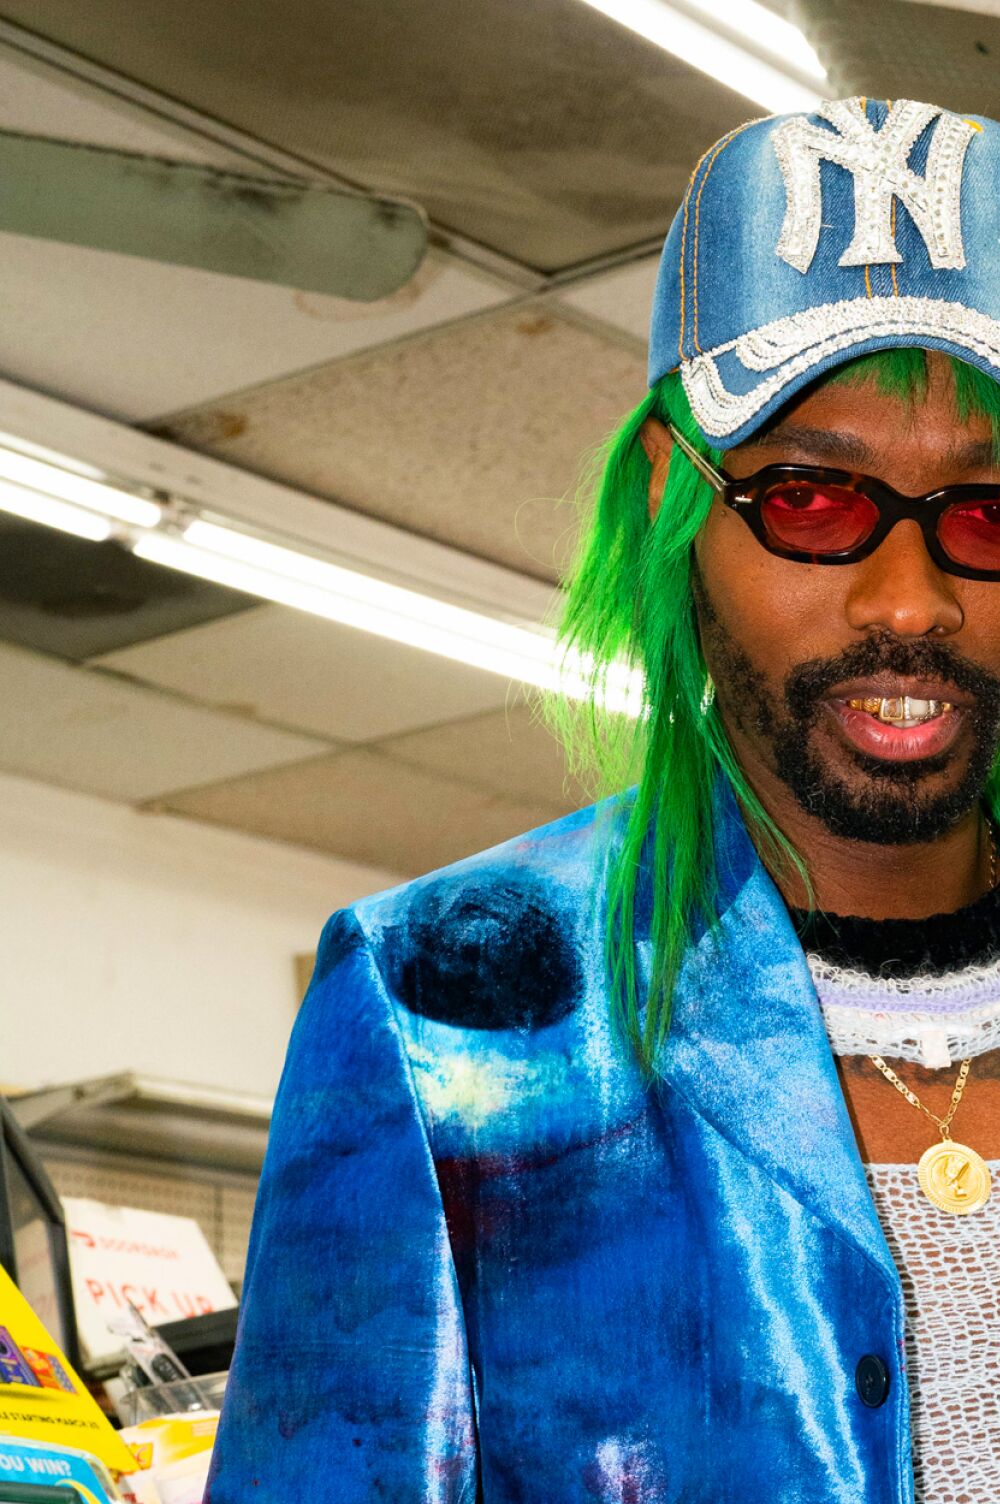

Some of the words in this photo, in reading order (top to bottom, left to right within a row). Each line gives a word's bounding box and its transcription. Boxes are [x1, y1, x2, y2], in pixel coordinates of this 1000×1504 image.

[771, 97, 982, 274] NY
[86, 1278, 170, 1316] PICK
[25, 1457, 73, 1477] WIN?
